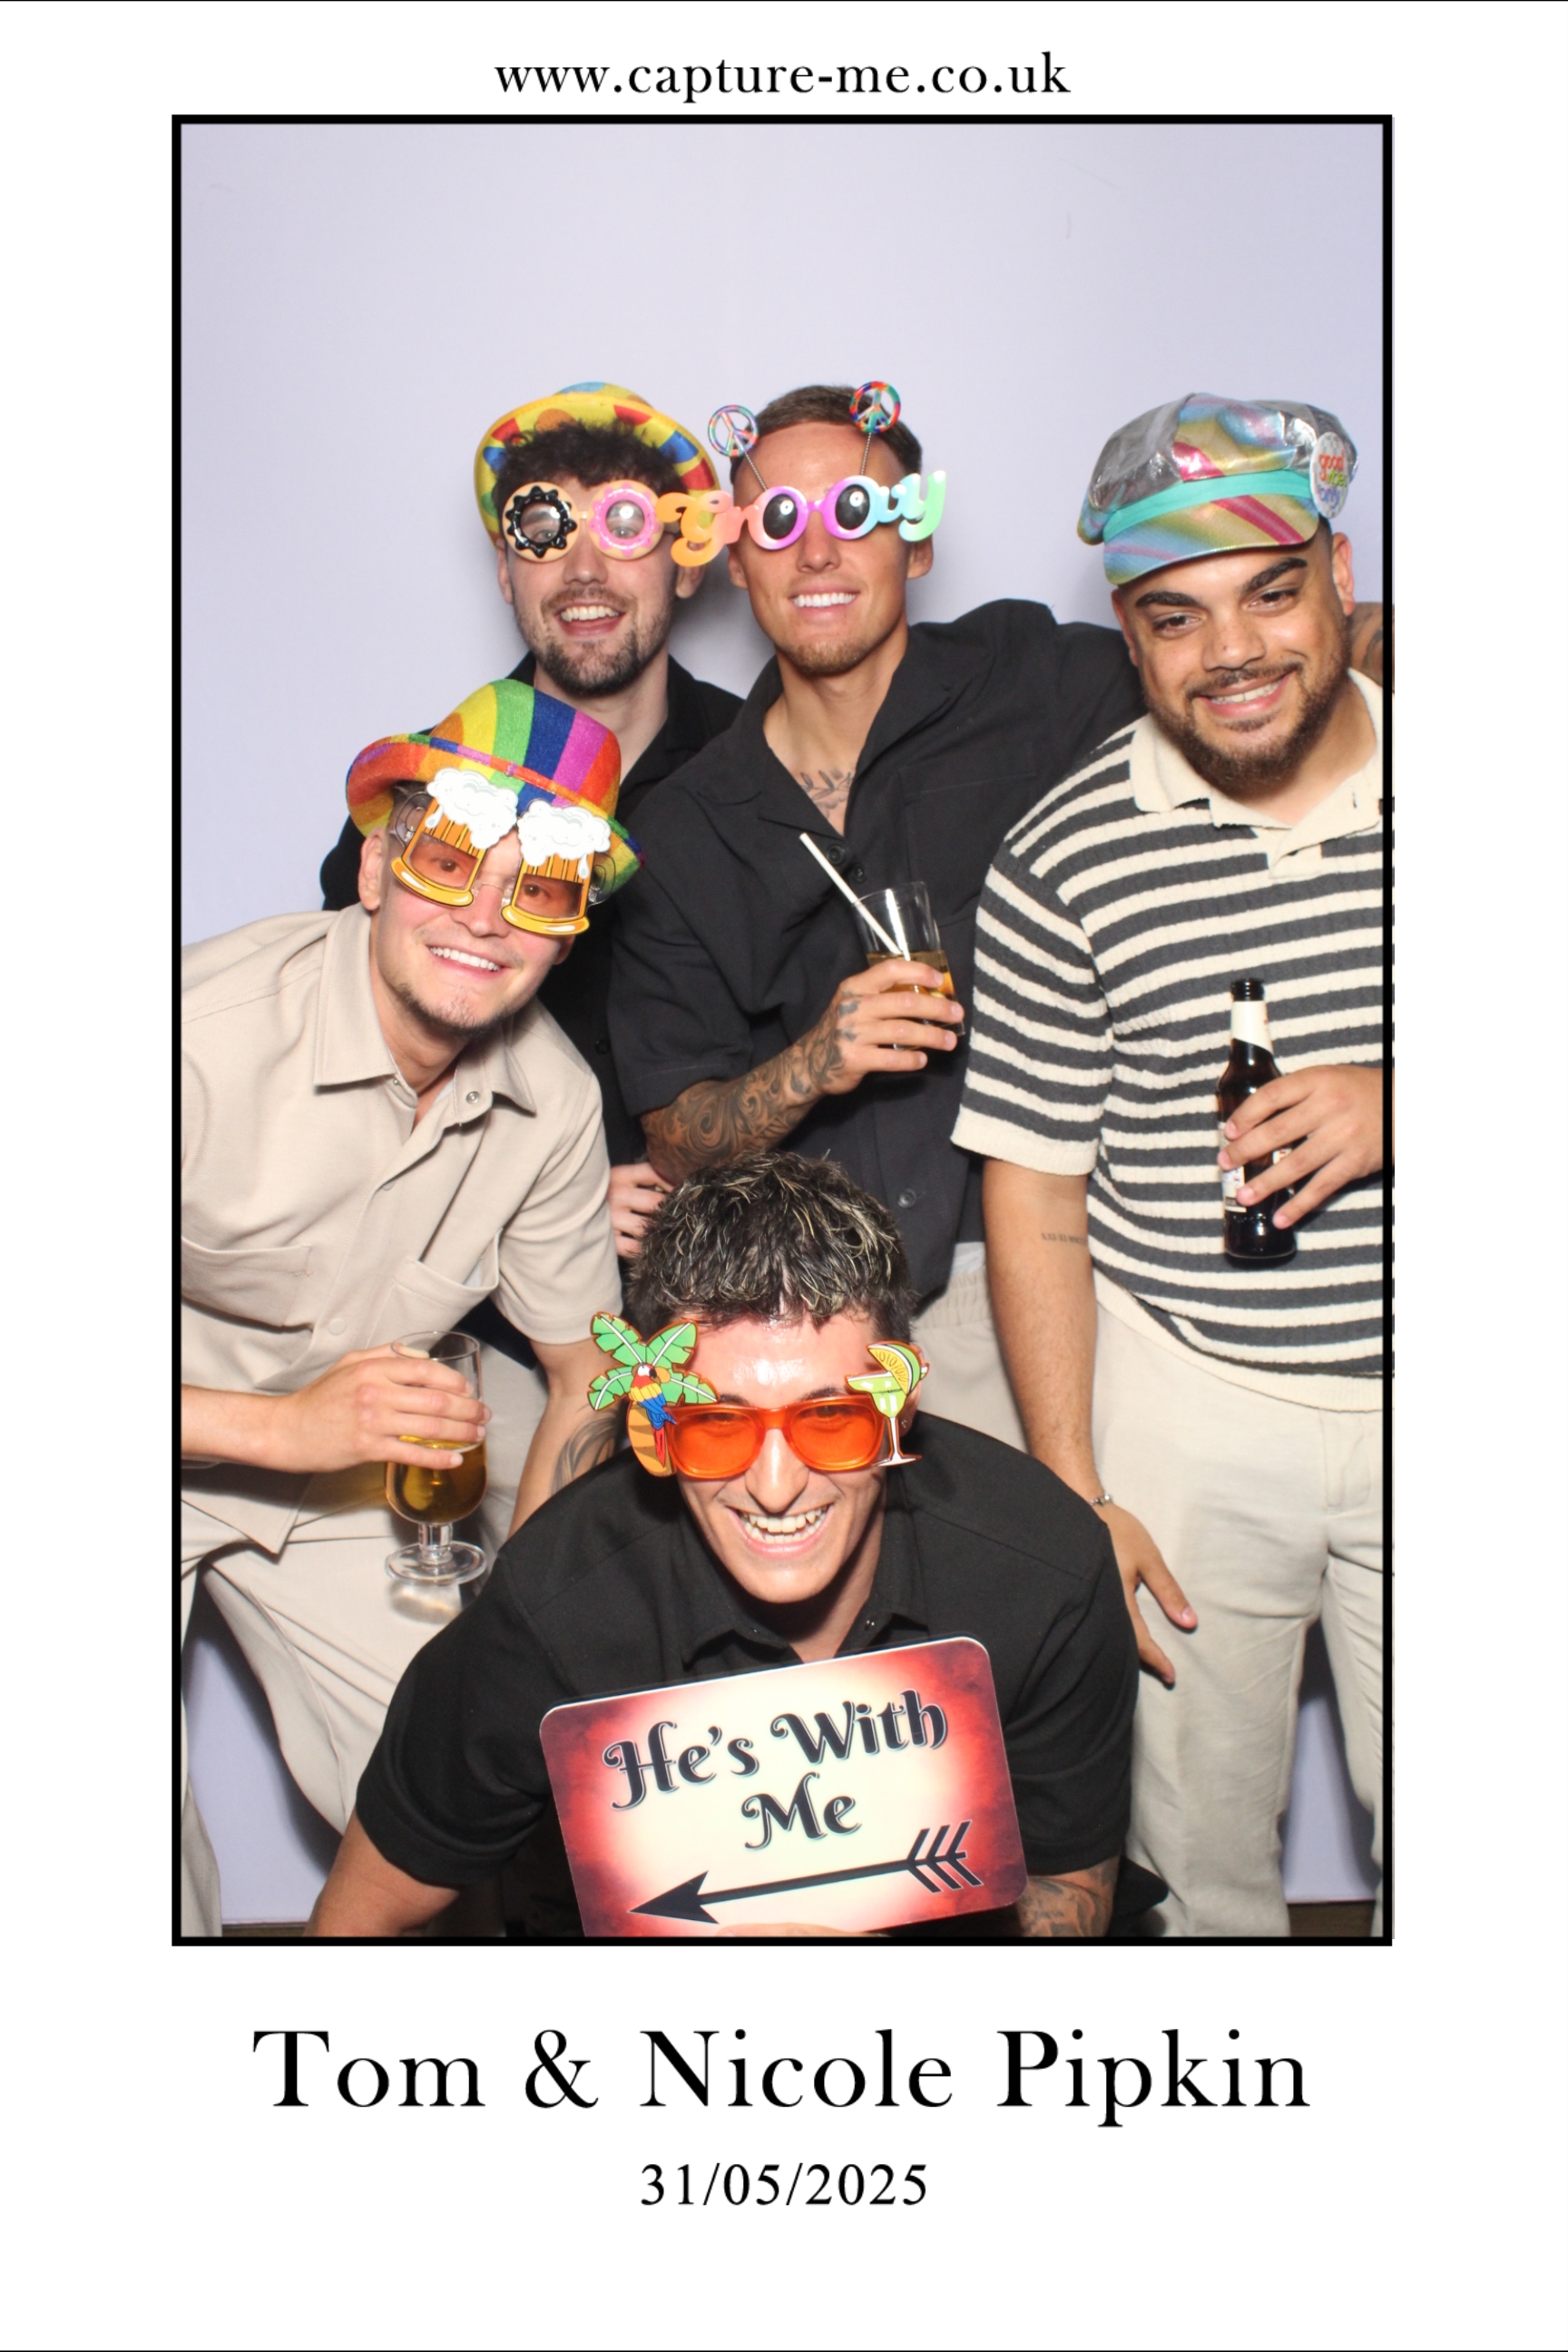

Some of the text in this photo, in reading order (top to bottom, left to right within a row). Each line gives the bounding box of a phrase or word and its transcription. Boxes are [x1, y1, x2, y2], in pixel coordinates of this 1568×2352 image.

[1318, 451, 1345, 481] good
[1318, 486, 1341, 510] only
[655, 470, 947, 568] groovy
[603, 1690, 948, 1811] He's With
[740, 1771, 862, 1852] Me
